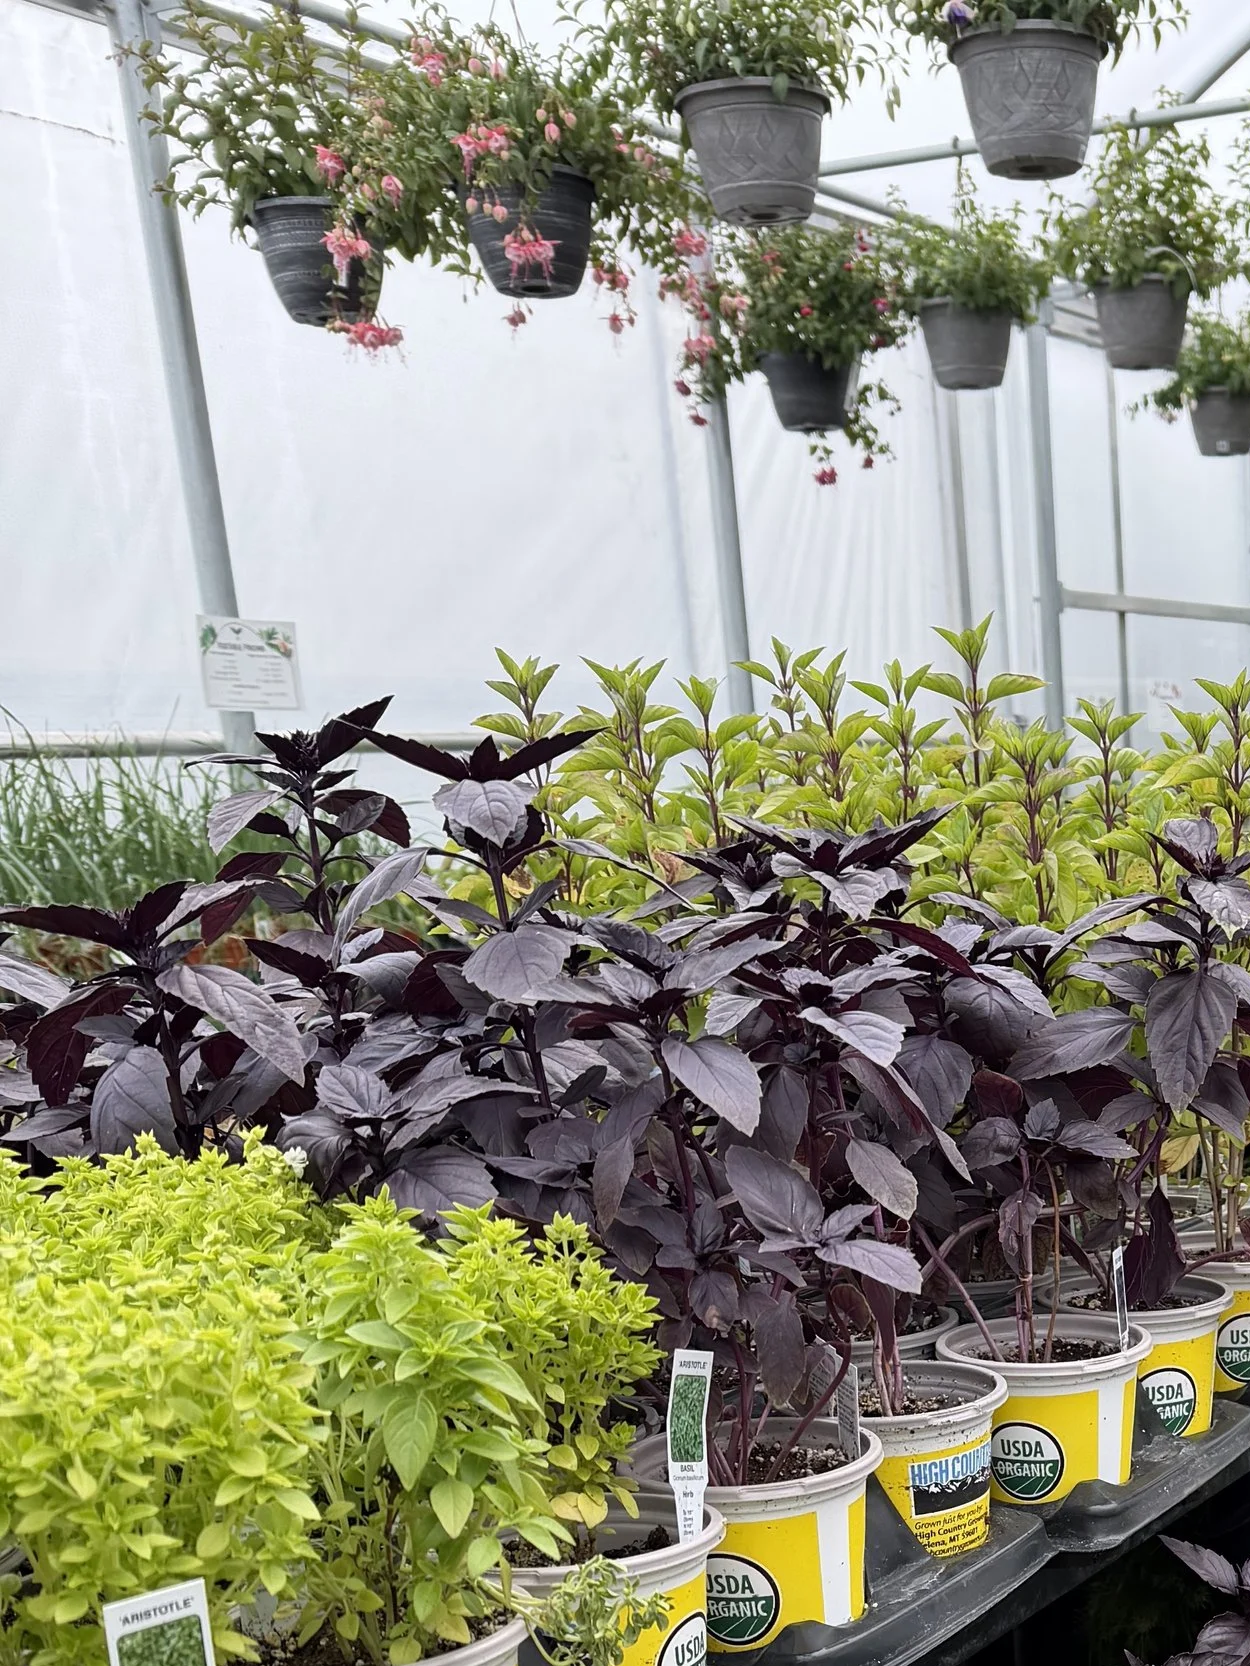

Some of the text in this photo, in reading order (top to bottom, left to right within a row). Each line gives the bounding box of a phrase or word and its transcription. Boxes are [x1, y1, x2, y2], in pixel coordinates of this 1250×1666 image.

[1145, 1383, 1184, 1401] USDA
[1001, 1439, 1045, 1458] USDA
[911, 1459, 950, 1486] HIGH
[997, 1460, 1055, 1478] ORGANIC
[914, 1519, 942, 1531] Grown
[915, 1529, 937, 1541] High
[937, 1522, 967, 1536] Country
[707, 1600, 768, 1618] RGANIC
[674, 1630, 705, 1666] USDA
